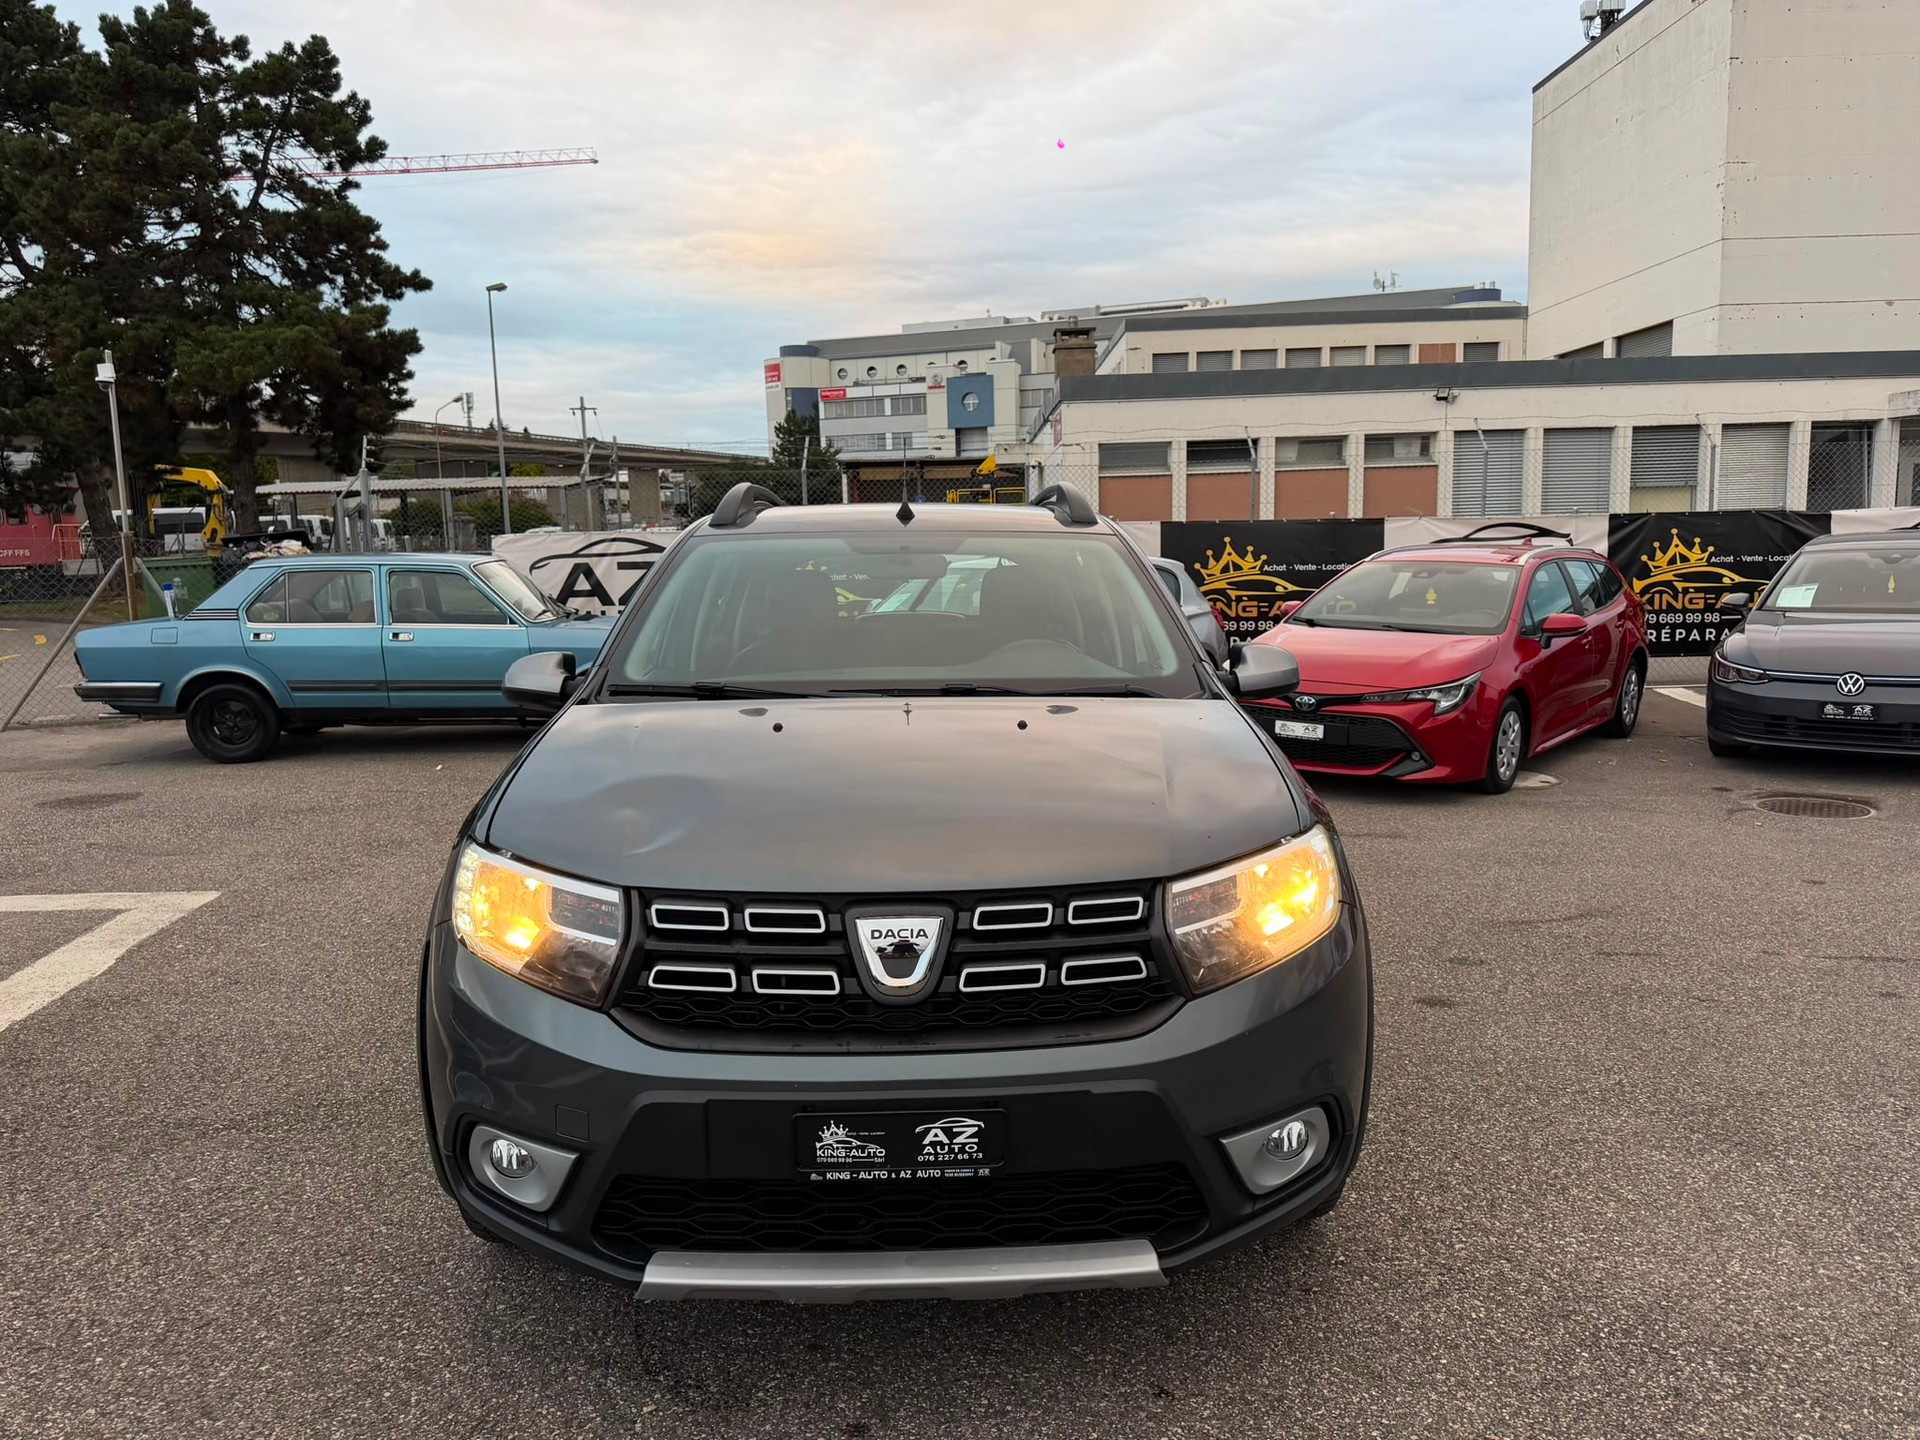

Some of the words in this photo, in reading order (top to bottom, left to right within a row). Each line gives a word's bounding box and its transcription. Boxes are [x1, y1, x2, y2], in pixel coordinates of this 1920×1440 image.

[1710, 555, 1734, 563] Achat
[1741, 554, 1763, 562] Vente
[1263, 563, 1287, 571] Achat
[1293, 563, 1317, 571] Vente
[1660, 612, 1683, 623] 669
[1685, 612, 1702, 623] 99
[1704, 612, 1720, 623] 98
[1240, 620, 1256, 631] 99
[1258, 620, 1274, 631] 98
[871, 928, 929, 940] DACIA
[922, 1127, 978, 1145] AZ
[922, 1144, 978, 1154] AUTO
[826, 1171, 851, 1180] KING
[858, 1171, 888, 1179] AUTO
[900, 1170, 912, 1178] AZ
[916, 1170, 941, 1178] AUTO
